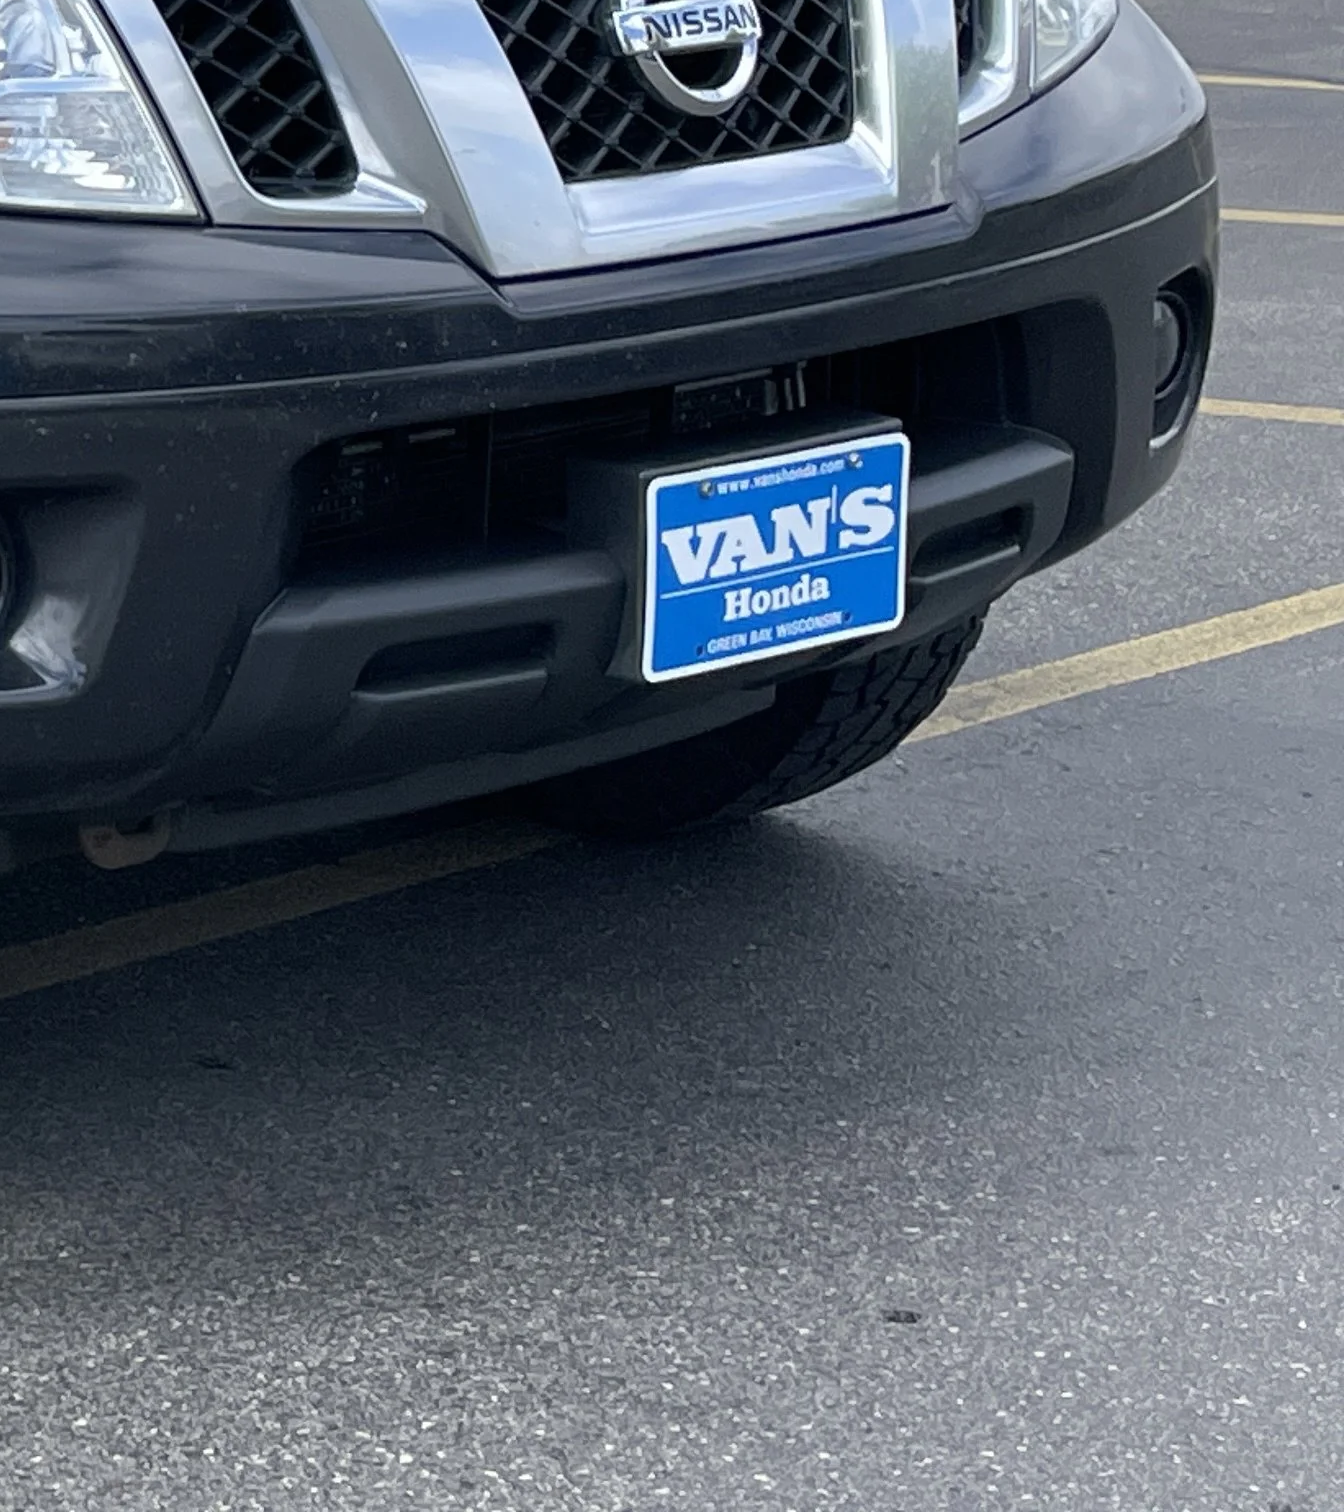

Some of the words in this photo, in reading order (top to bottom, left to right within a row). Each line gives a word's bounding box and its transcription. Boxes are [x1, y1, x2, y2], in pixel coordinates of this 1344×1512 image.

[642, 3, 758, 42] NISSAN
[660, 483, 896, 585] VAN'S
[722, 572, 831, 622] Honda
[706, 632, 748, 654] GREEN
[775, 611, 844, 638] WISCONSIN
